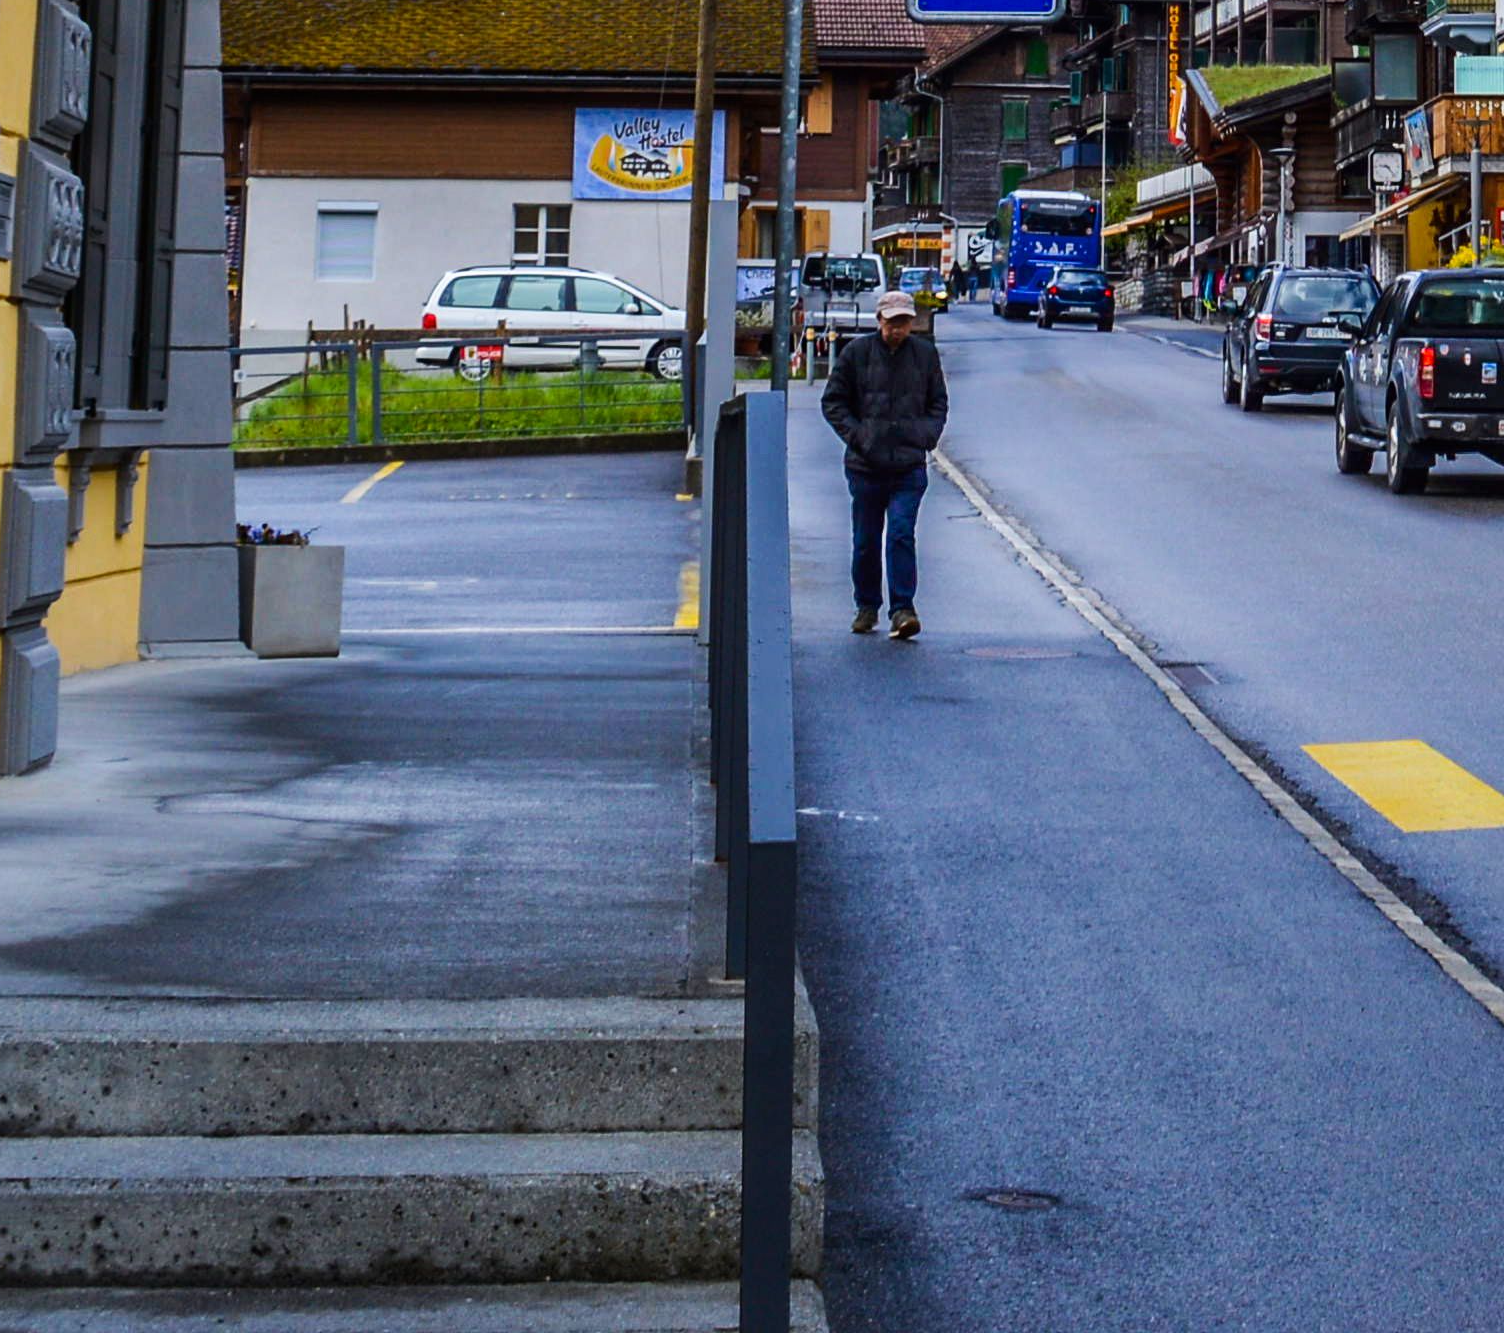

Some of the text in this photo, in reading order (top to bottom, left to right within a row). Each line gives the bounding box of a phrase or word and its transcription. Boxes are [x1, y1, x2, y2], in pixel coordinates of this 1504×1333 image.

[1169, 5, 1179, 50] HOTEL
[614, 117, 660, 139] Valley
[638, 123, 685, 150] Hostel
